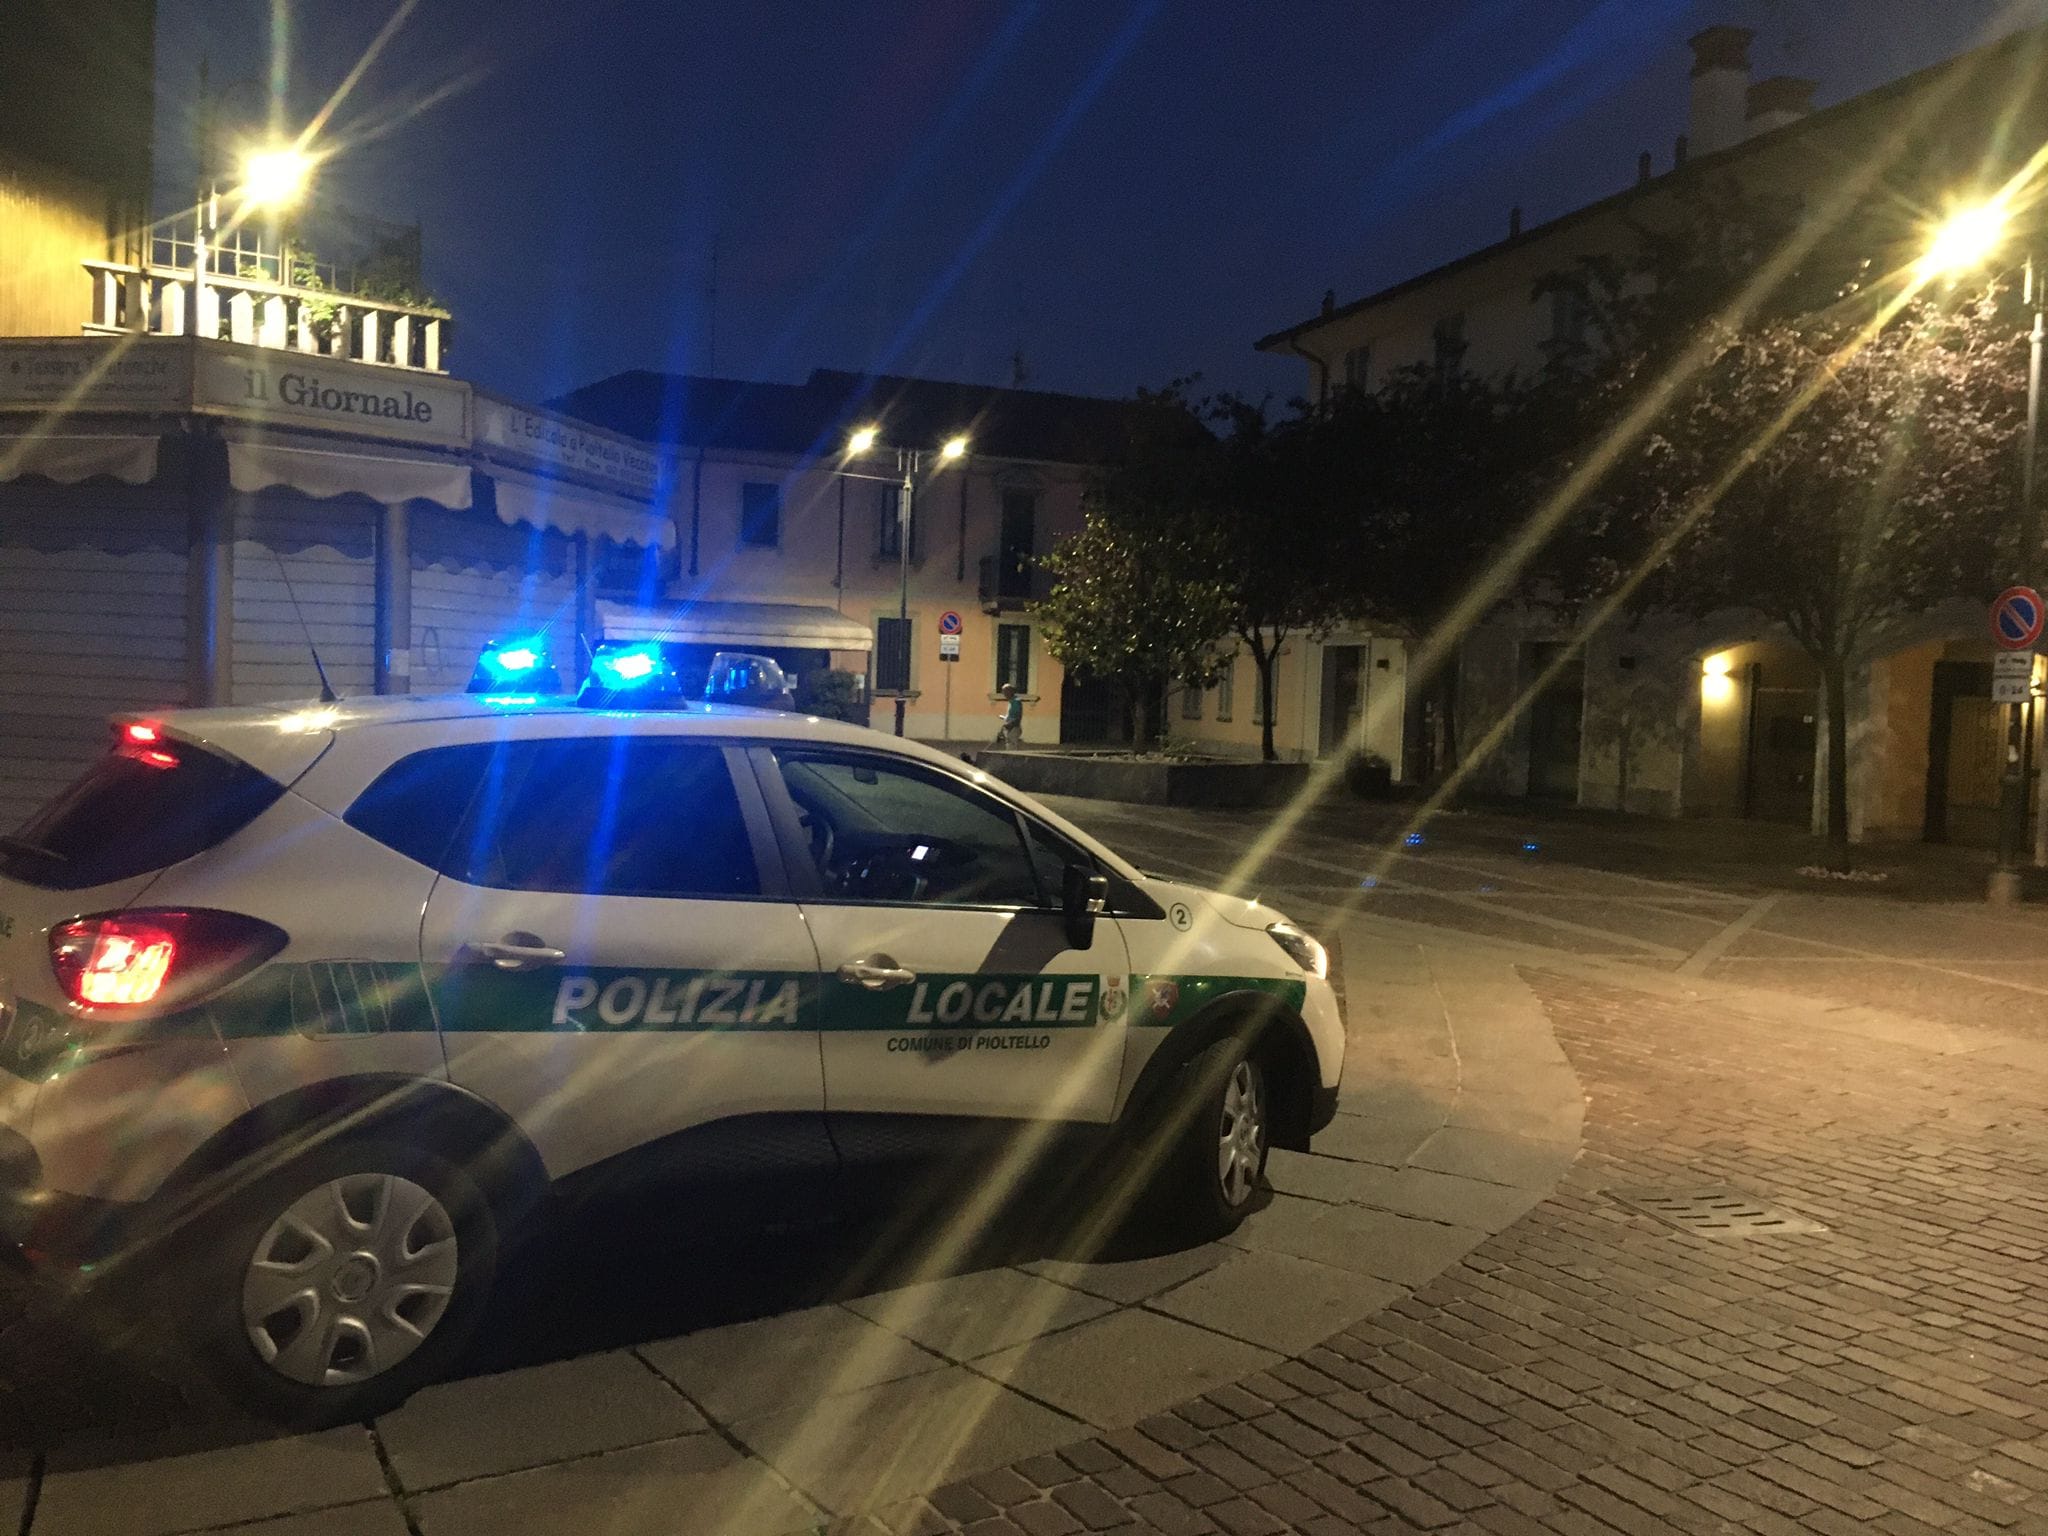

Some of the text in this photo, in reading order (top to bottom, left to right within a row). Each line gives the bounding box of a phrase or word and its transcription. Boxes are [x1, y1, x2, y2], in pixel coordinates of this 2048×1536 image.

[244, 368, 433, 423] il Giornale
[1176, 909, 1187, 925] 2
[551, 975, 1094, 1025] POLIZIA LOCALE
[887, 1035, 1051, 1052] COMUNE DI PIOLTELLO
